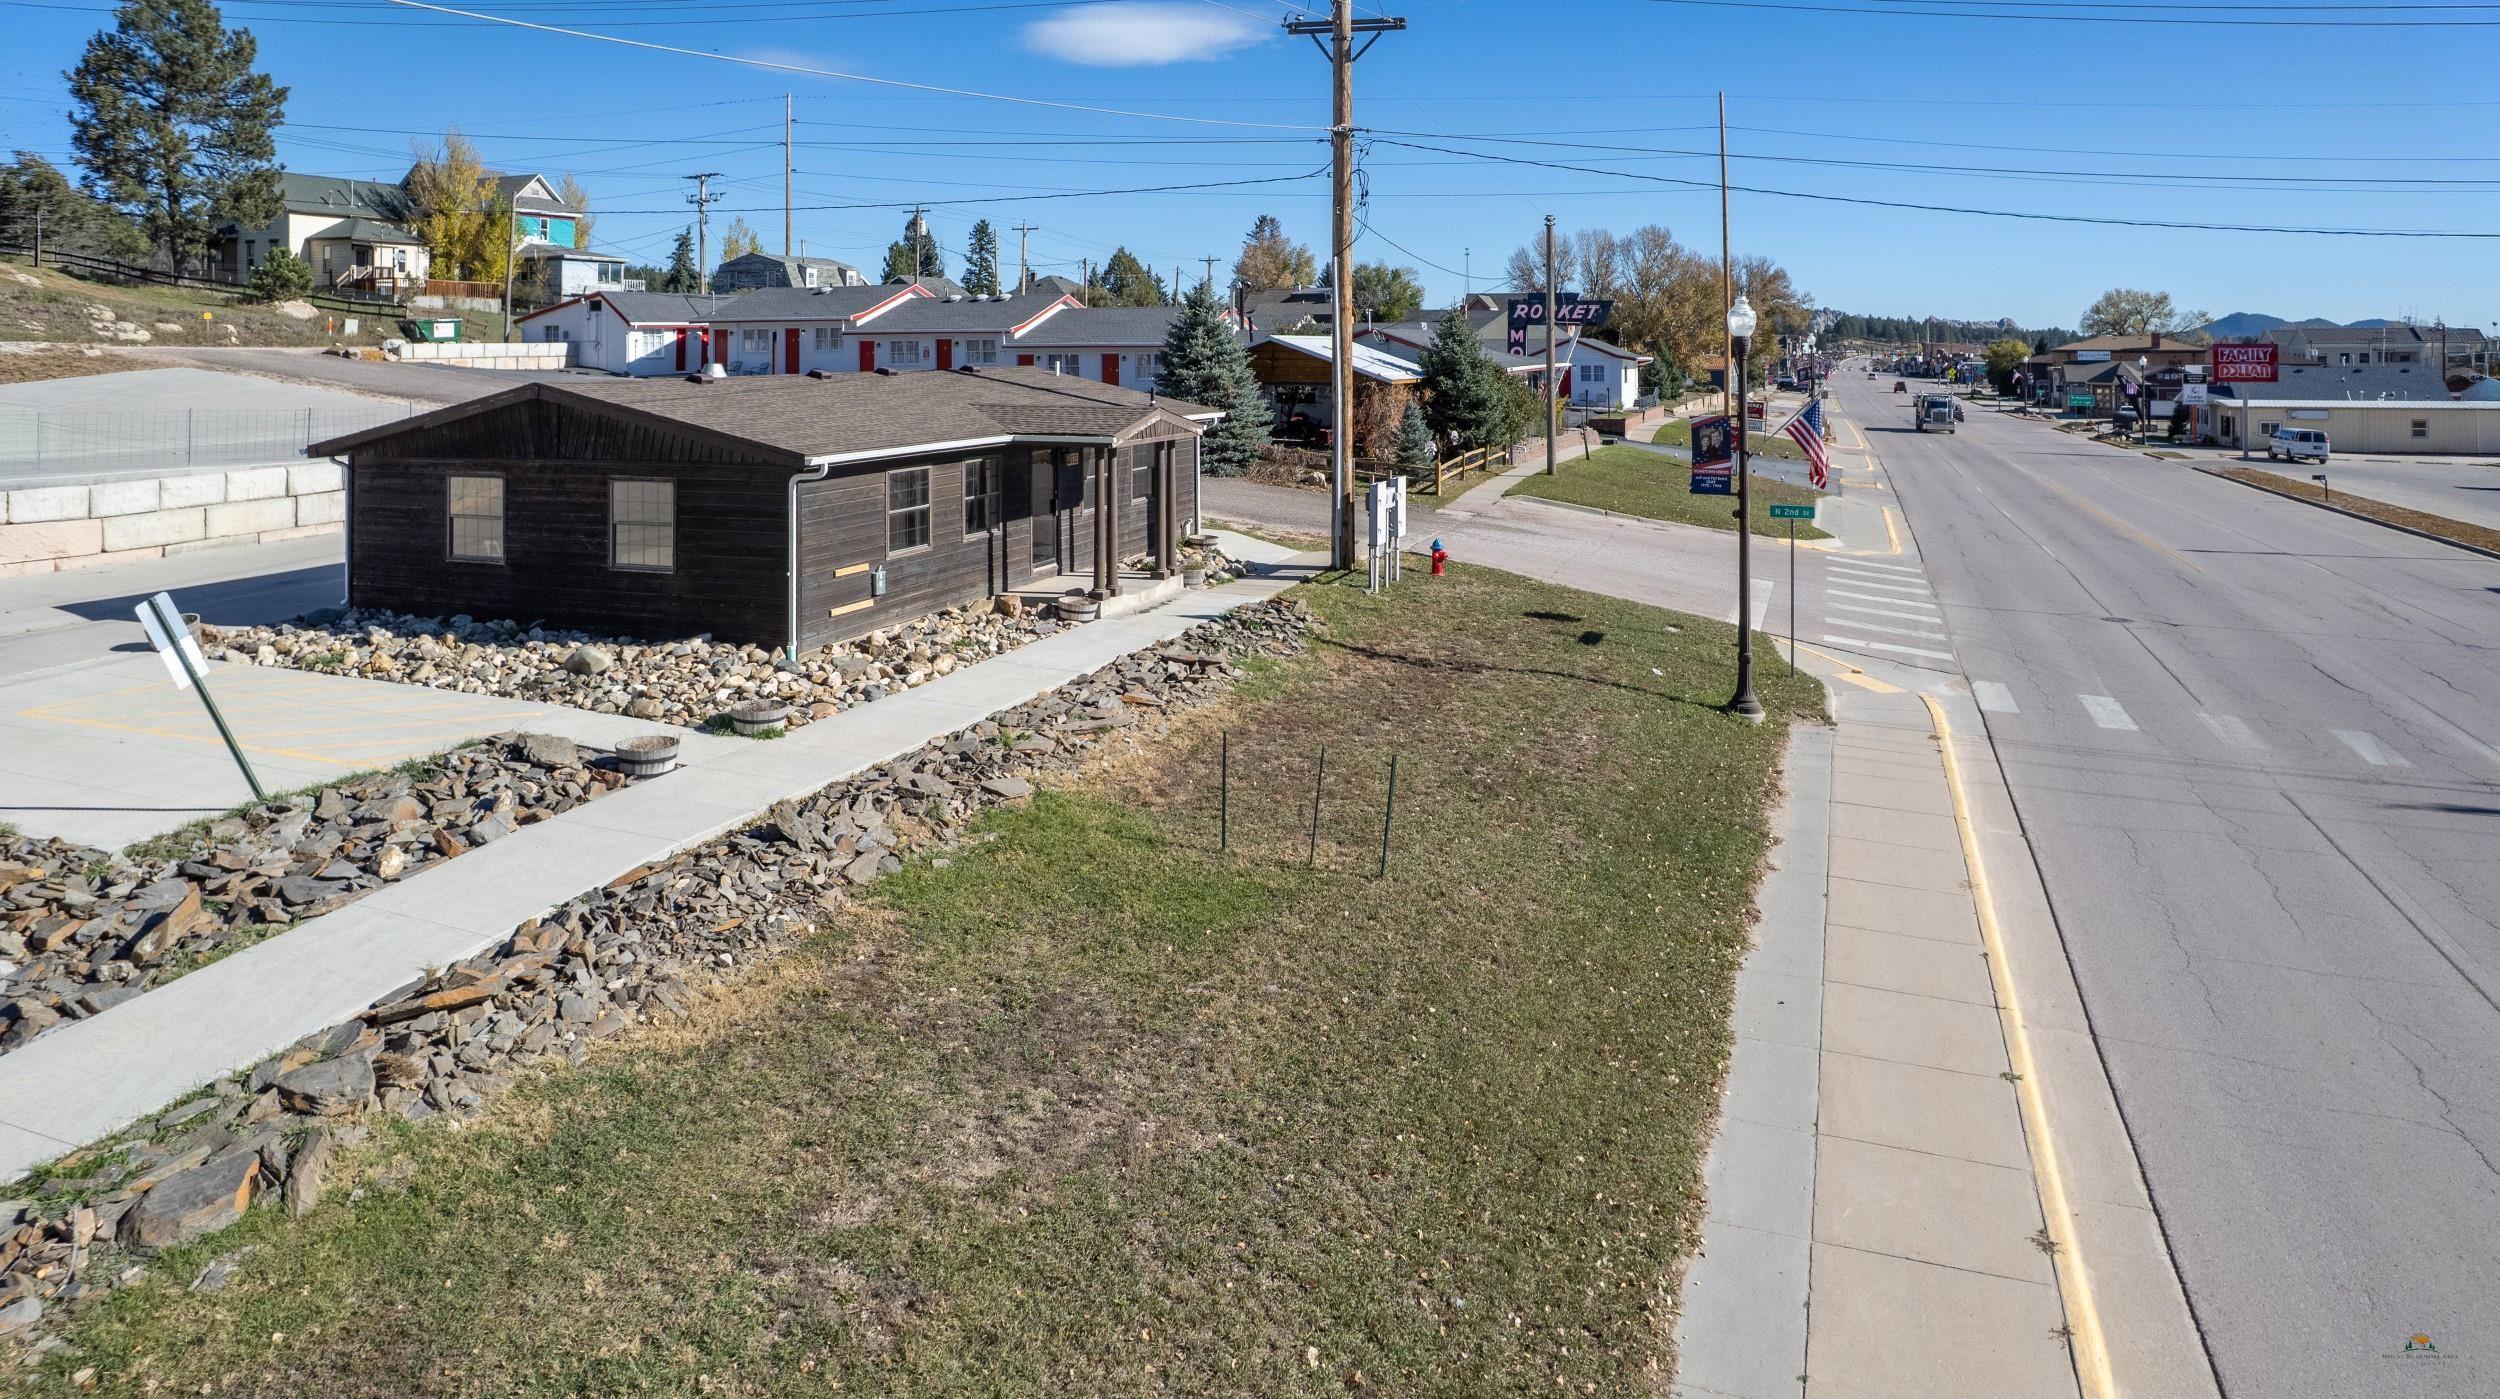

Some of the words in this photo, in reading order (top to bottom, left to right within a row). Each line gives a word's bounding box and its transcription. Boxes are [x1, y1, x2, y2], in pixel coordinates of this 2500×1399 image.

[1513, 304, 1600, 319] ROKET
[2218, 347, 2272, 362] FAMILY
[2218, 363, 2272, 378] DOLLAR
[1784, 508, 1799, 516] 2nd
